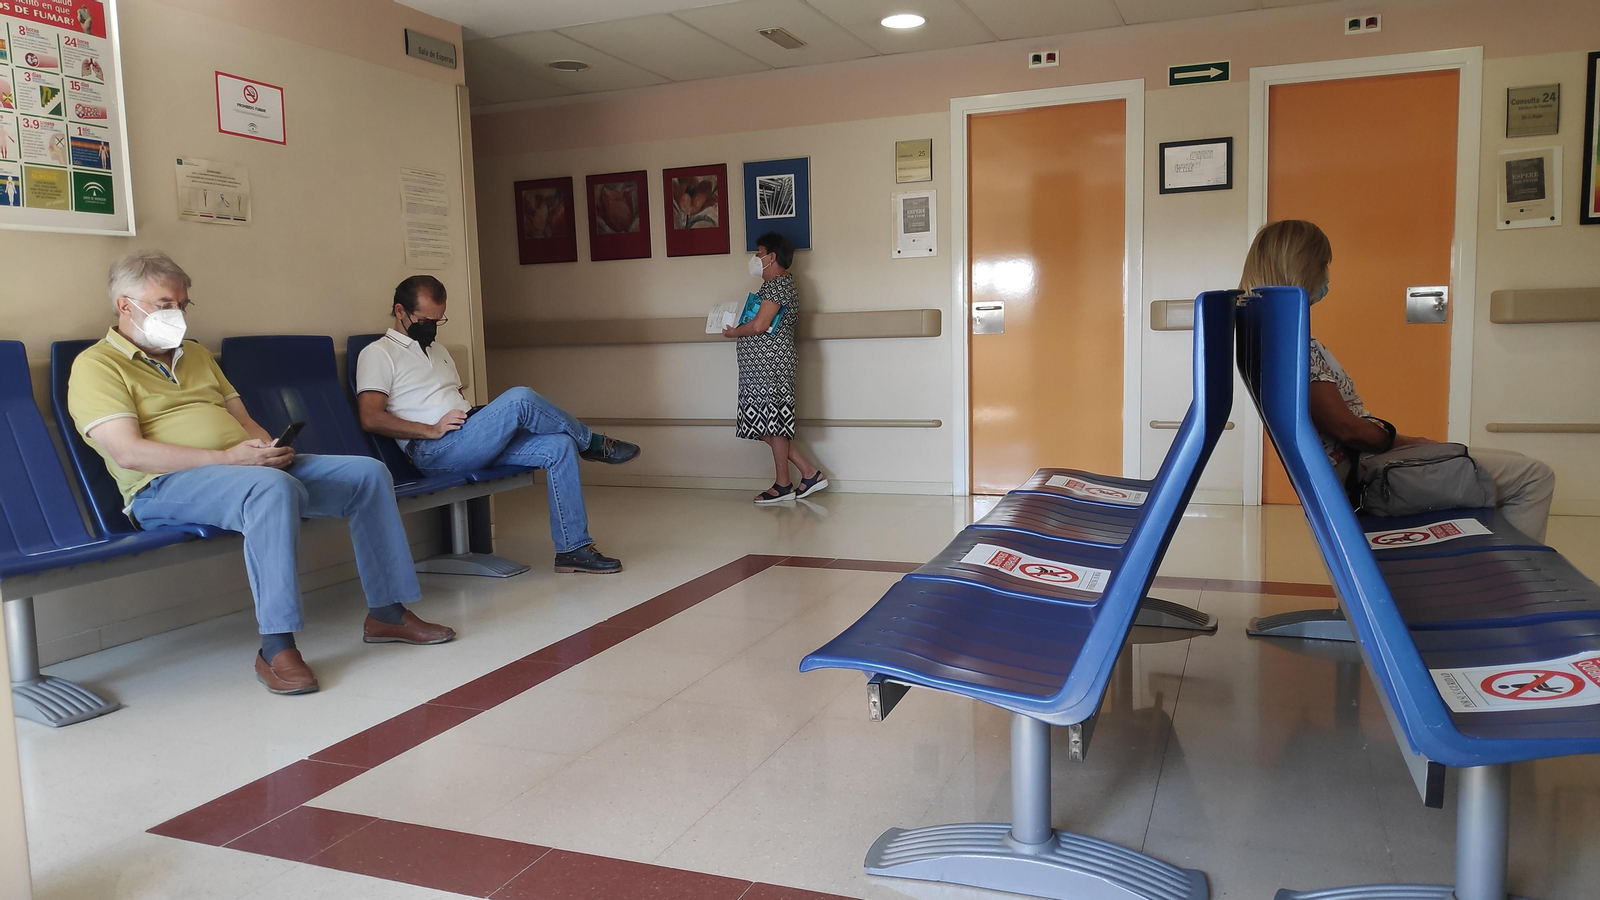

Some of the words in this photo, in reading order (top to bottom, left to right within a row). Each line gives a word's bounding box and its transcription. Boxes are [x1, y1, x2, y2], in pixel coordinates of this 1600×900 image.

[41, 2, 52, 10] en
[55, 5, 70, 14] que
[14, 5, 29, 15] DE
[34, 9, 75, 26] FUMAR?
[19, 25, 26, 36] 8
[64, 36, 77, 47] 24
[418, 46, 428, 57] Sala
[430, 50, 435, 59] de
[24, 71, 31, 82] 3
[70, 80, 81, 91] 15
[1511, 97, 1540, 105] Consulta
[1542, 91, 1556, 103] 24
[77, 126, 82, 136] 1
